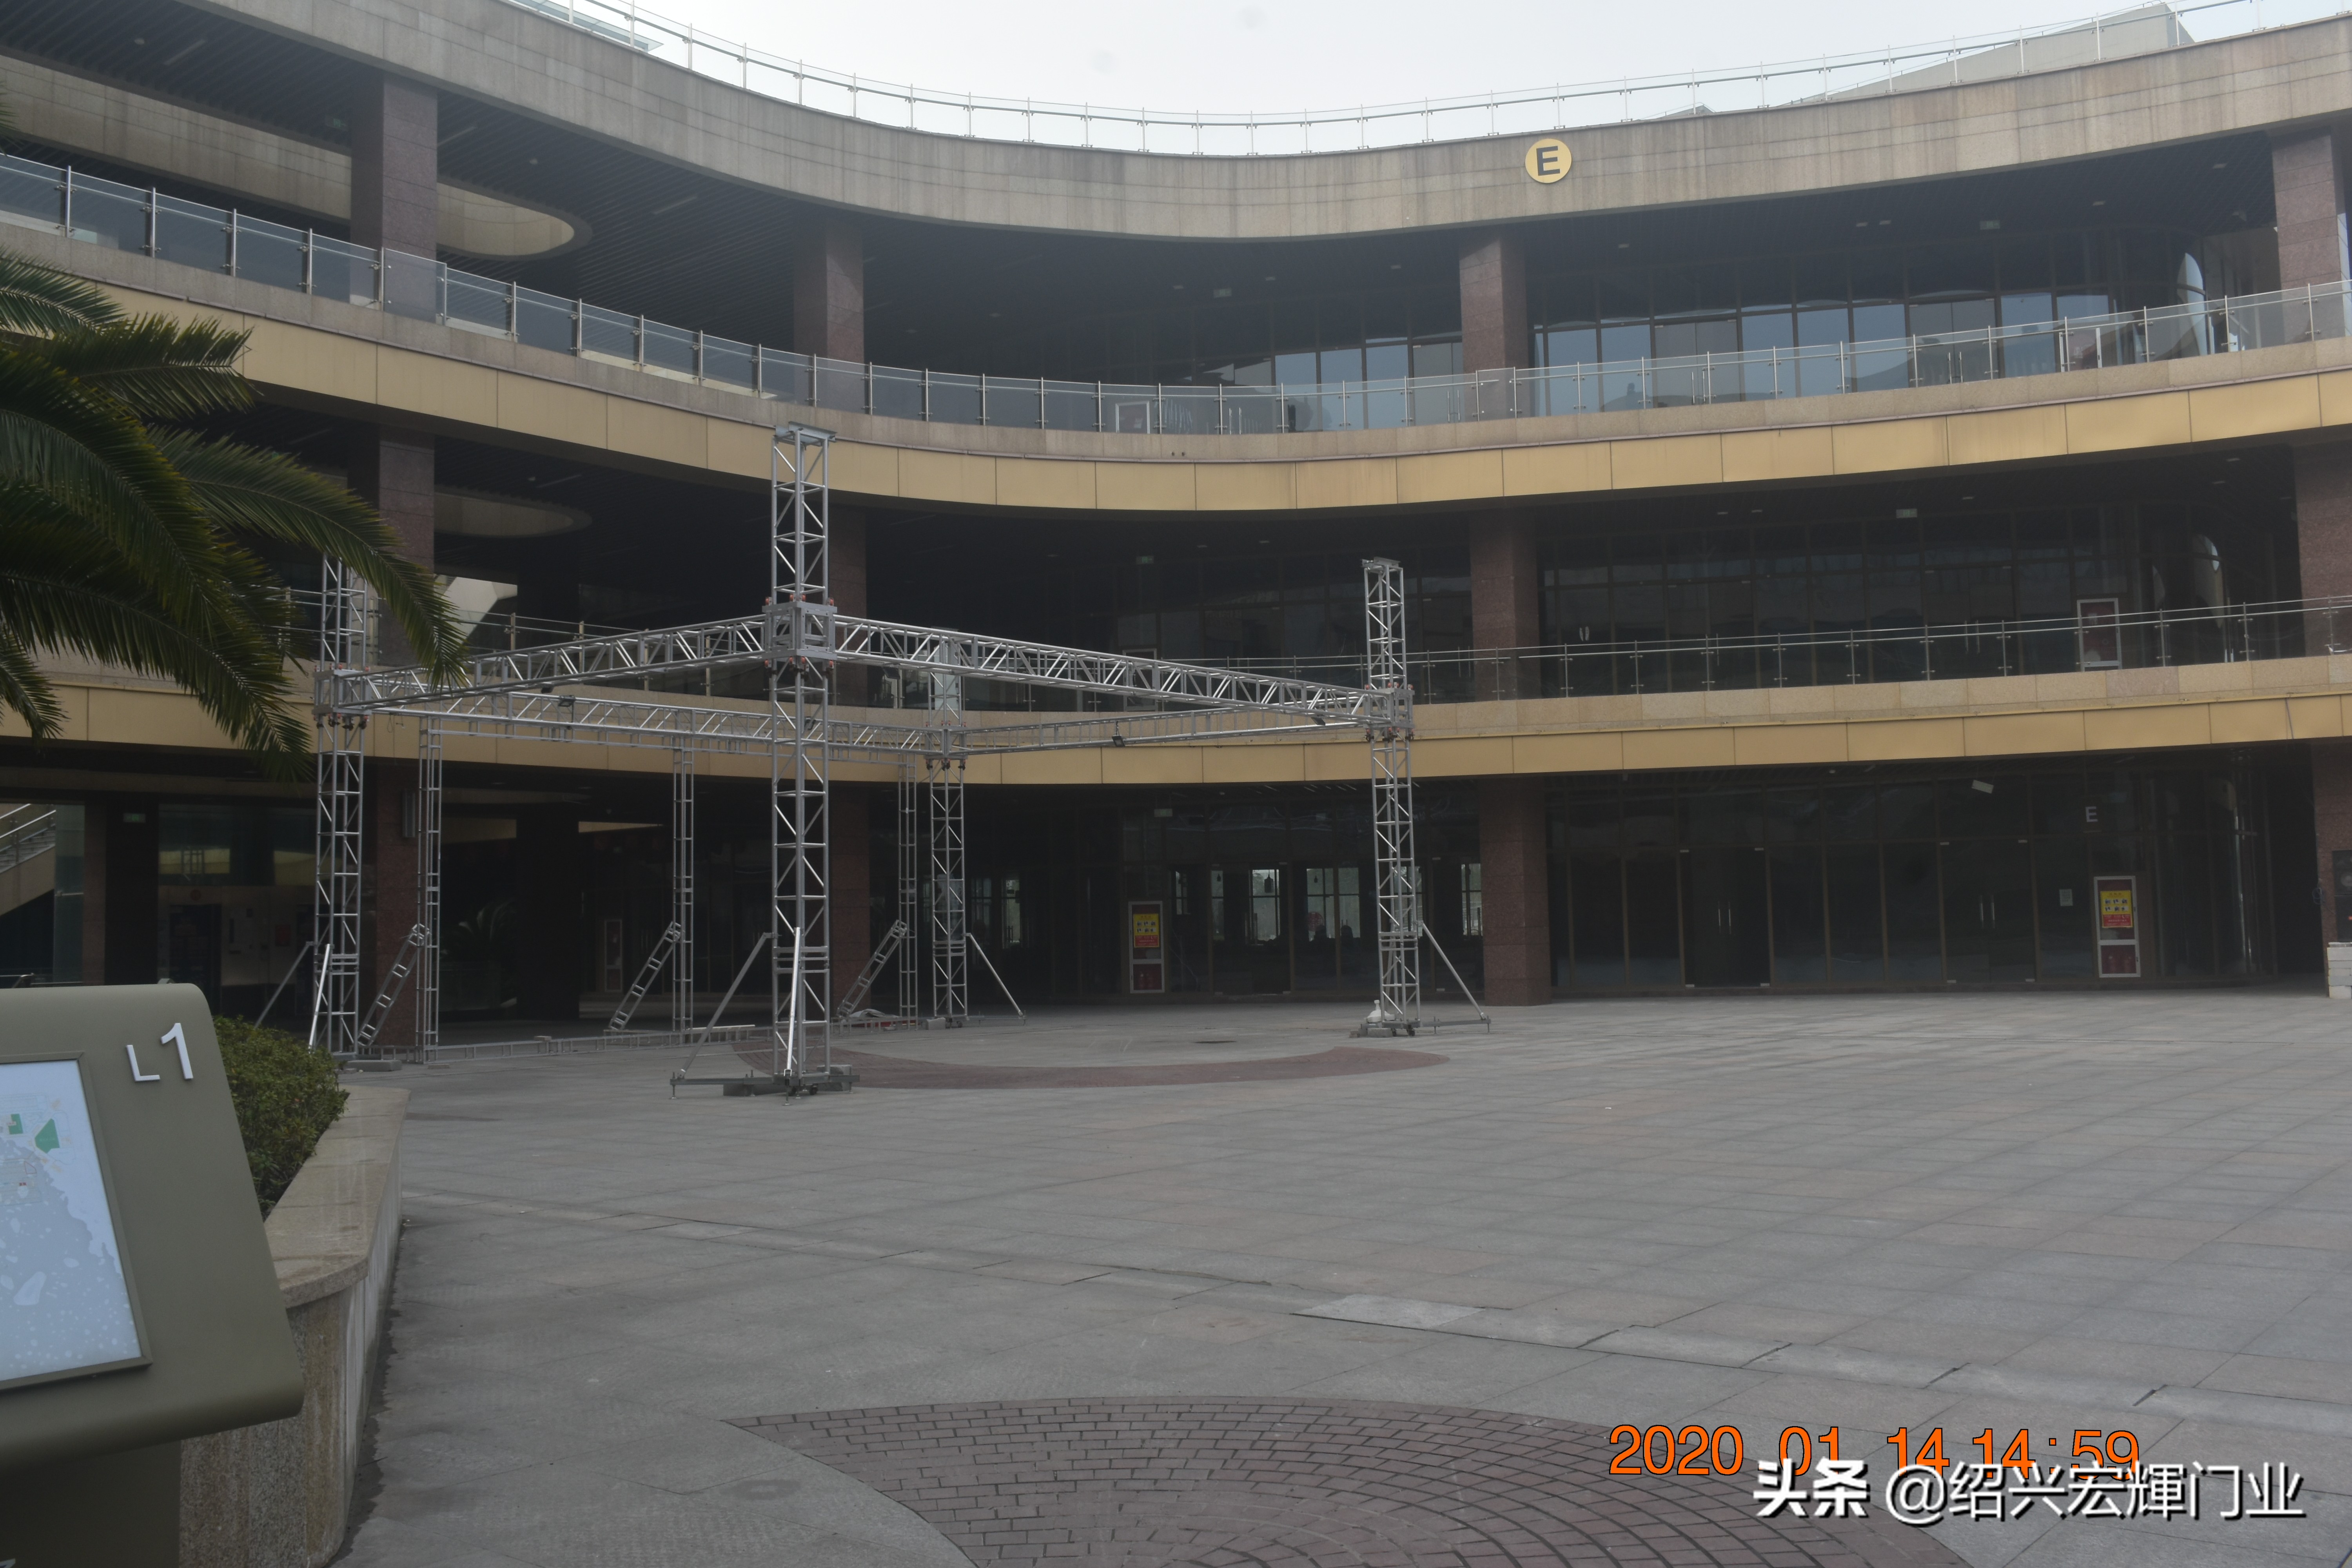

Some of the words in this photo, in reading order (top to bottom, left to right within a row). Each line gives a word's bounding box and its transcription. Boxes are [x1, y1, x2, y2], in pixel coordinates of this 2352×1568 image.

[1536, 145, 1561, 176] E
[2085, 806, 2098, 822] E
[126, 1022, 194, 1082] L1
